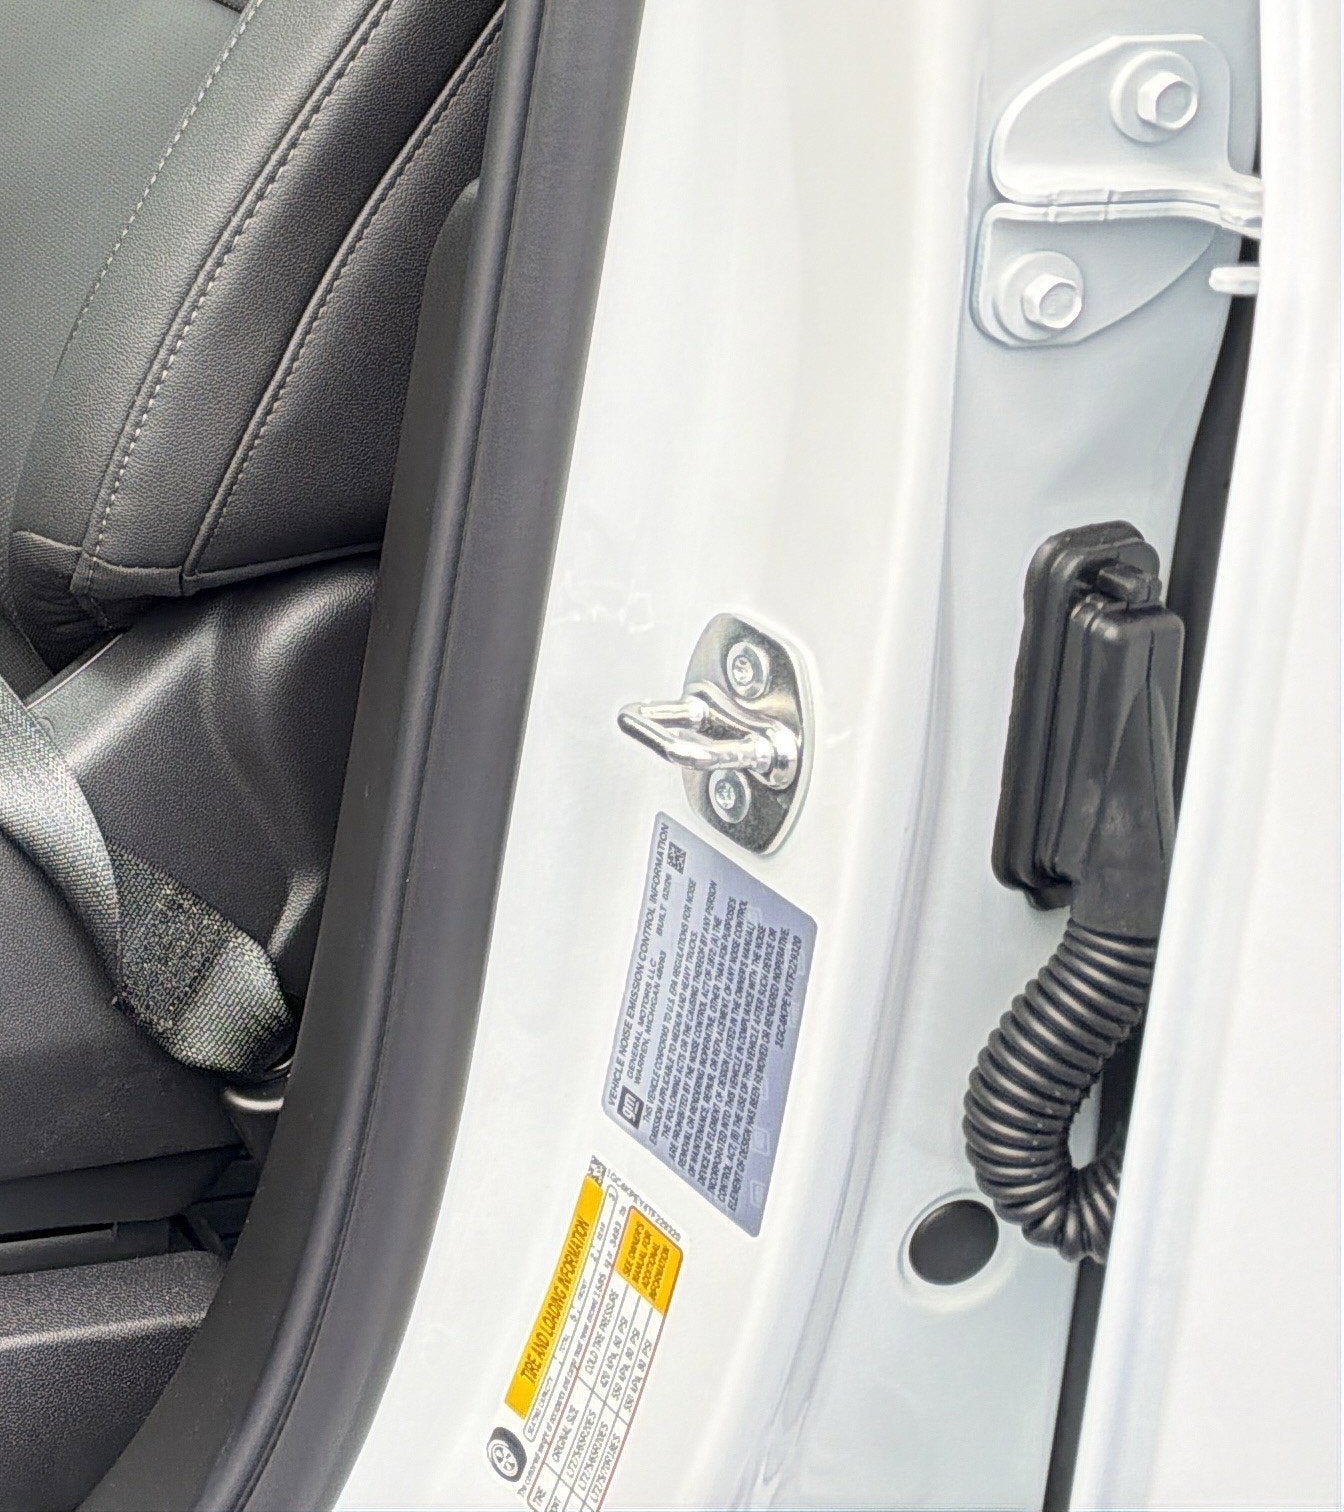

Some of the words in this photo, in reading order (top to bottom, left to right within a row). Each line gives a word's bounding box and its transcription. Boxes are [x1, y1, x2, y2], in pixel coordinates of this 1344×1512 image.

[655, 903, 666, 936] BUILT
[608, 1056, 624, 1108] VEHICLE
[618, 1017, 632, 1058] NOISE
[625, 960, 644, 1020] EMISSION
[637, 903, 655, 962] CONTROL
[648, 821, 669, 905] INFORMATION
[626, 1027, 643, 1080] GENERAL
[637, 980, 652, 1028] MOTORS
[647, 957, 656, 981] LLC
[634, 1034, 650, 1087] WARREN,
[644, 979, 660, 1036] MICHIGAN
[557, 1213, 589, 1292] INFORMATION
[530, 1327, 549, 1362] AND
[539, 1282, 566, 1339] LOADING
[520, 1351, 540, 1388] TIRE
